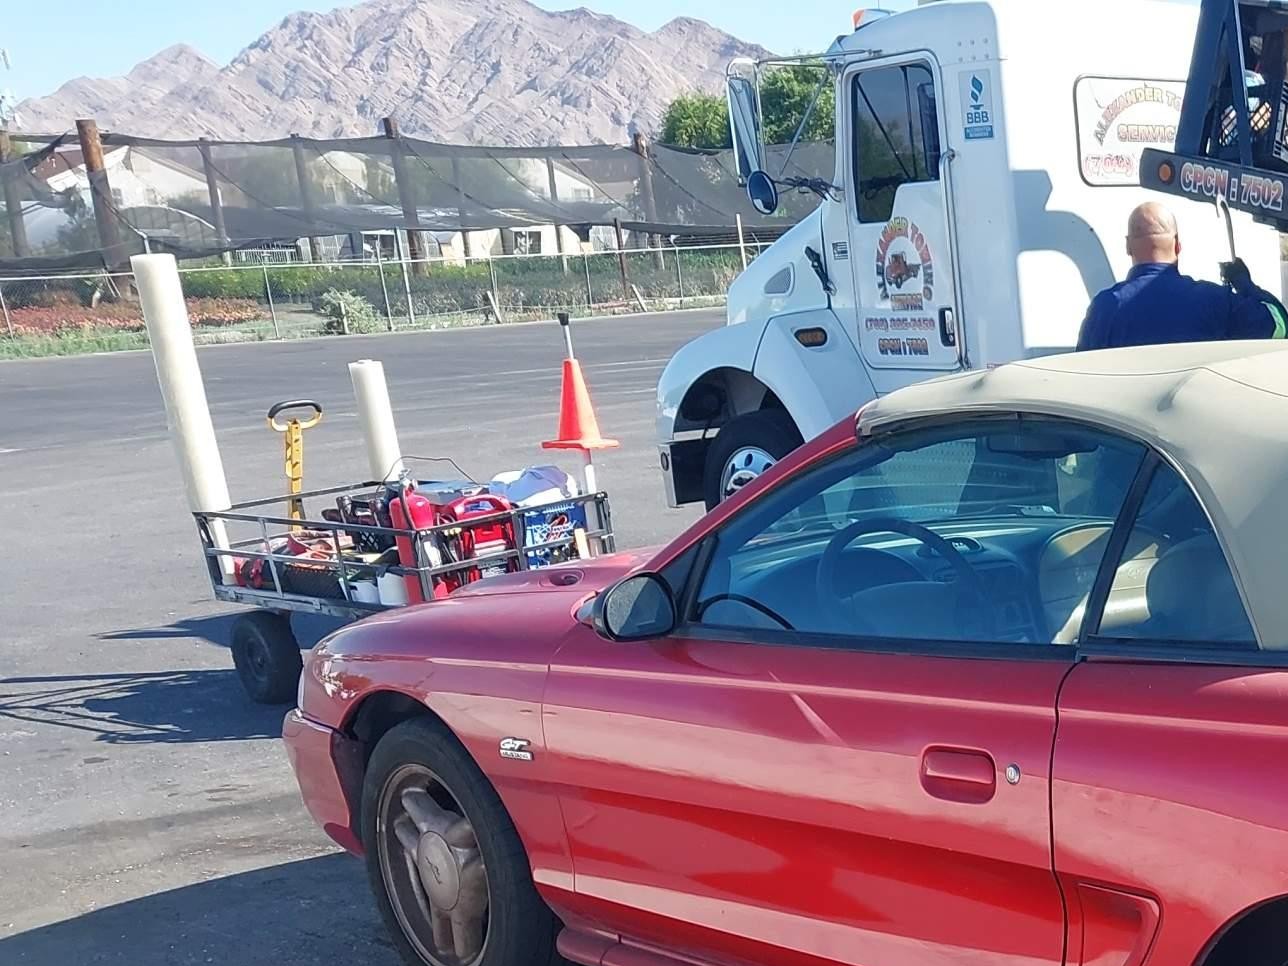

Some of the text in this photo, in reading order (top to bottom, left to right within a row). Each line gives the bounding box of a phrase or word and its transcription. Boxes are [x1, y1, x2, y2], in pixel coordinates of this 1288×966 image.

[966, 110, 990, 124] BBB
[1117, 123, 1176, 143] SERVIC
[1181, 162, 1229, 200] CPCN
[1241, 173, 1284, 211] 7502
[500, 738, 530, 750] GT
